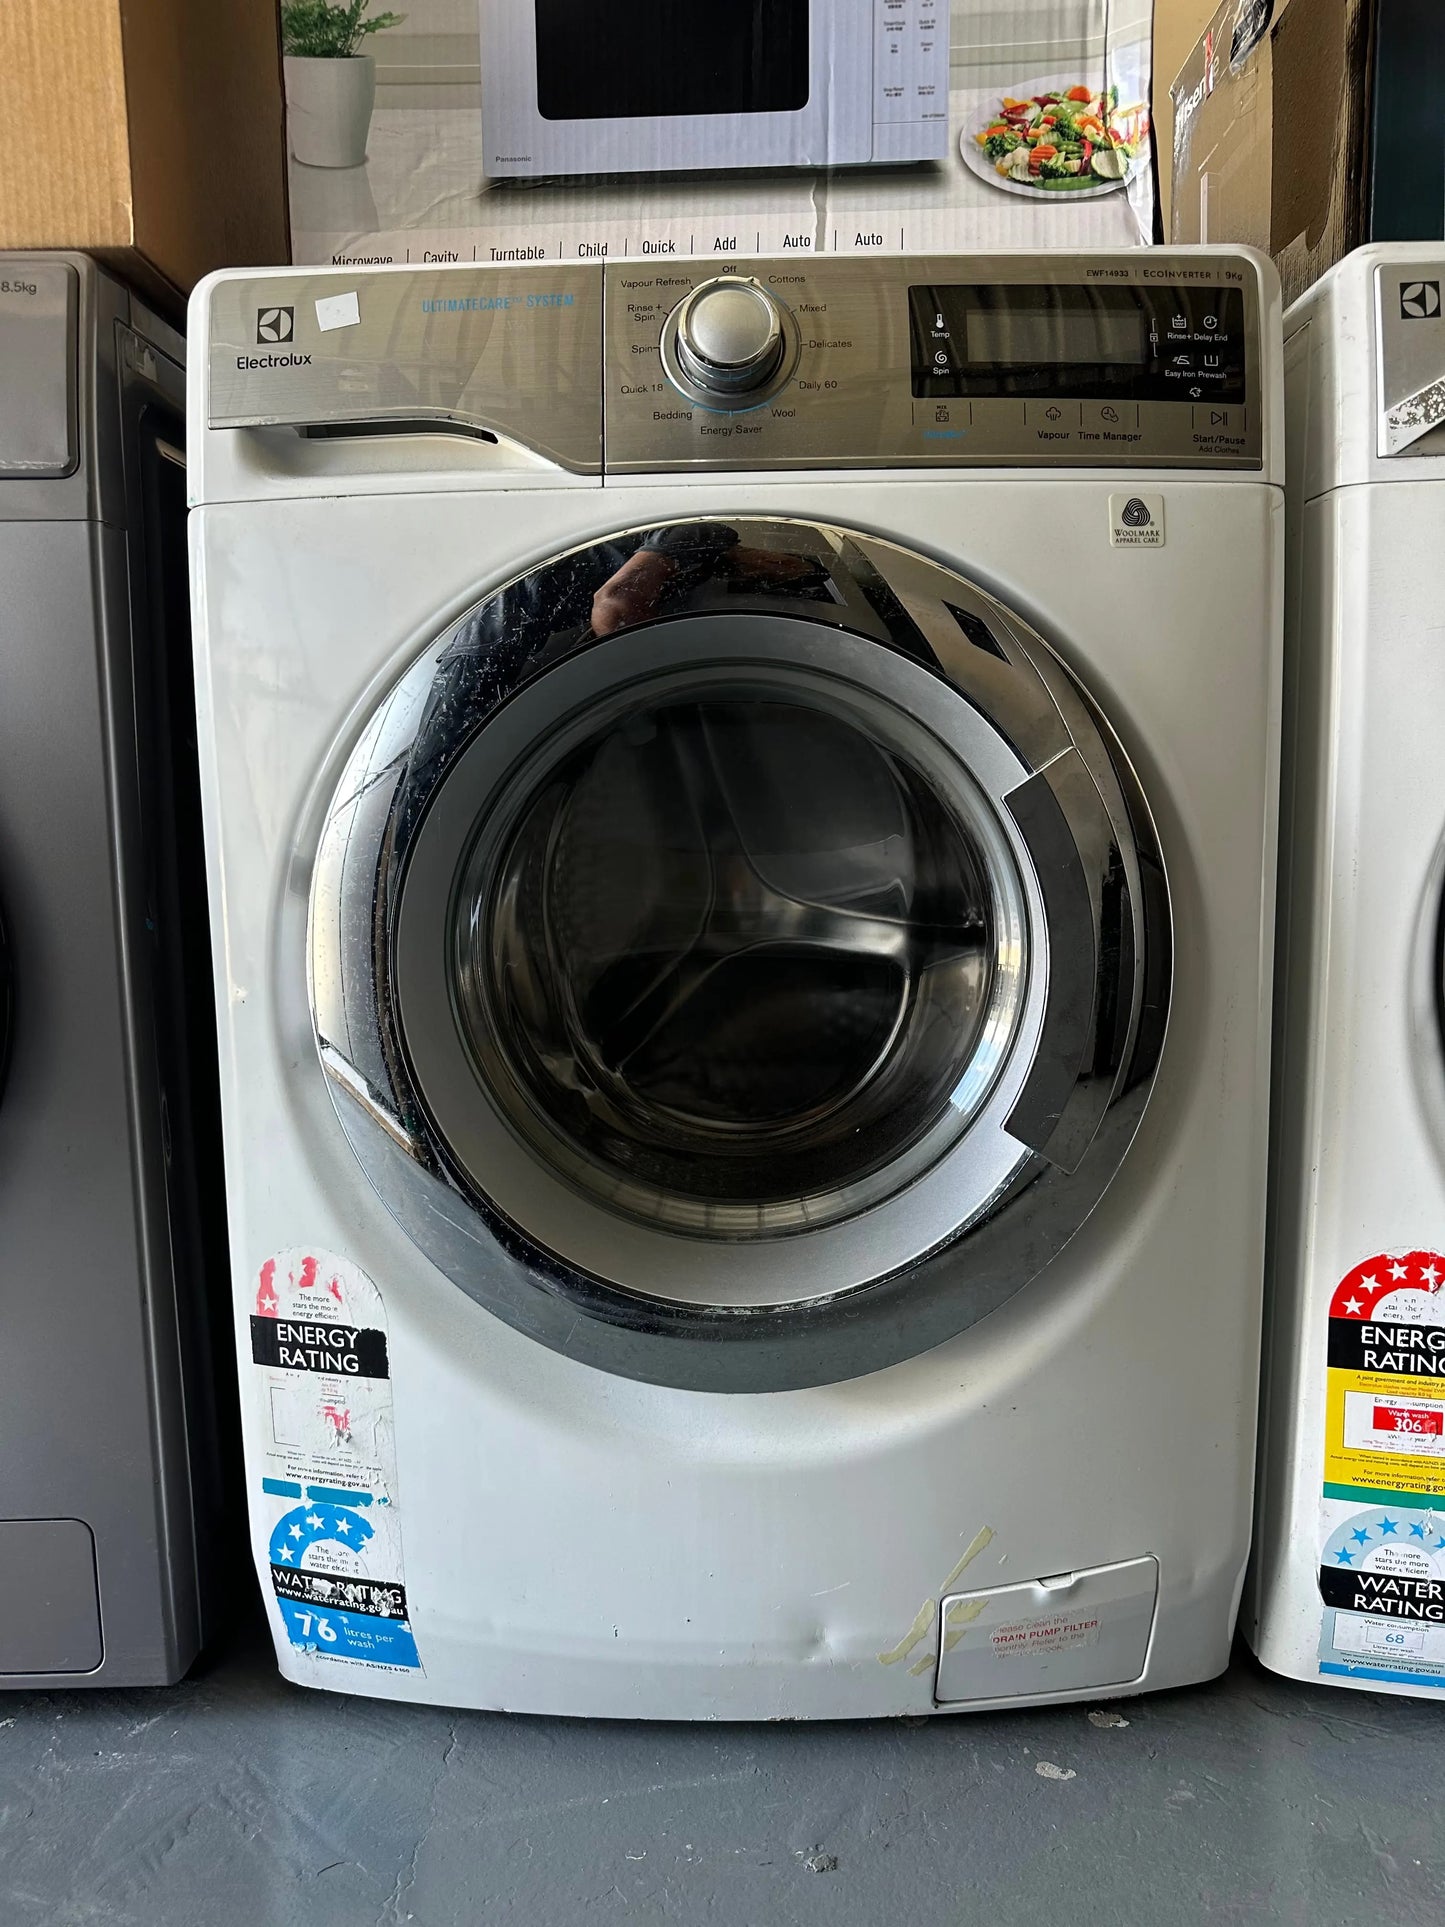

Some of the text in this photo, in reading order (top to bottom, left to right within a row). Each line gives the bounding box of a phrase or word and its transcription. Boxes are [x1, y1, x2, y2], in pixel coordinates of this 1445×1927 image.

[495, 155, 532, 164] Panasonic
[713, 236, 737, 251] Add
[783, 234, 811, 248] Auto
[854, 232, 883, 246] Auto
[578, 243, 608, 257] Child
[642, 239, 676, 254] Quick
[489, 246, 545, 261] Turntable
[722, 265, 737, 273] Off
[1086, 269, 1129, 277] EWF14933
[621, 277, 691, 288] Vapour Refresh
[768, 274, 806, 284] Cottons
[1, 281, 37, 295] 8.5kg
[527, 293, 574, 308] SYSTEM
[627, 304, 654, 312] Rinse
[799, 304, 827, 312] Mixed
[634, 313, 656, 322] Spin
[930, 331, 950, 340] Temp
[1194, 333, 1228, 343] Delay End
[631, 344, 653, 353] Spin
[809, 339, 853, 348] Delicates
[236, 353, 312, 371] Electrolux
[933, 367, 950, 376] Spin
[1165, 370, 1196, 380] Easy Iron
[1198, 370, 1227, 380] Prewash
[621, 383, 664, 394] Quick 18
[799, 380, 838, 390] Daily 60
[653, 411, 692, 420] Bedding
[771, 409, 796, 417] Wool
[700, 425, 763, 436] Energy Saver
[1037, 430, 1070, 442] Vapour
[1078, 432, 1142, 443] Time Manager
[1192, 434, 1246, 445] Start/Pause
[1114, 528, 1160, 537] WOOLMARK
[299, 1293, 312, 1301] The
[292, 1311, 313, 1319] energy
[276, 1323, 359, 1349] ENERGY
[278, 1347, 359, 1373] RATING
[1393, 1417, 1422, 1432] 306
[286, 1471, 370, 1488] www.energyrating.gov.au
[1391, 1472, 1425, 1481] information,
[315, 1545, 330, 1554] The
[308, 1554, 325, 1562] stars
[310, 1561, 330, 1570] water
[1357, 1574, 1444, 1601] WATER
[1353, 1593, 1444, 1620] RATING
[293, 1611, 338, 1642] 76
[1053, 1617, 1068, 1625] the
[1364, 1619, 1385, 1627] Water
[1029, 1627, 1061, 1639] PUMP
[1063, 1620, 1098, 1632] FILTER
[343, 1627, 395, 1644] litres per
[1385, 1633, 1405, 1644] 68
[347, 1638, 376, 1649] wash
[1342, 1658, 1441, 1675] www.waterrating.gov.au
